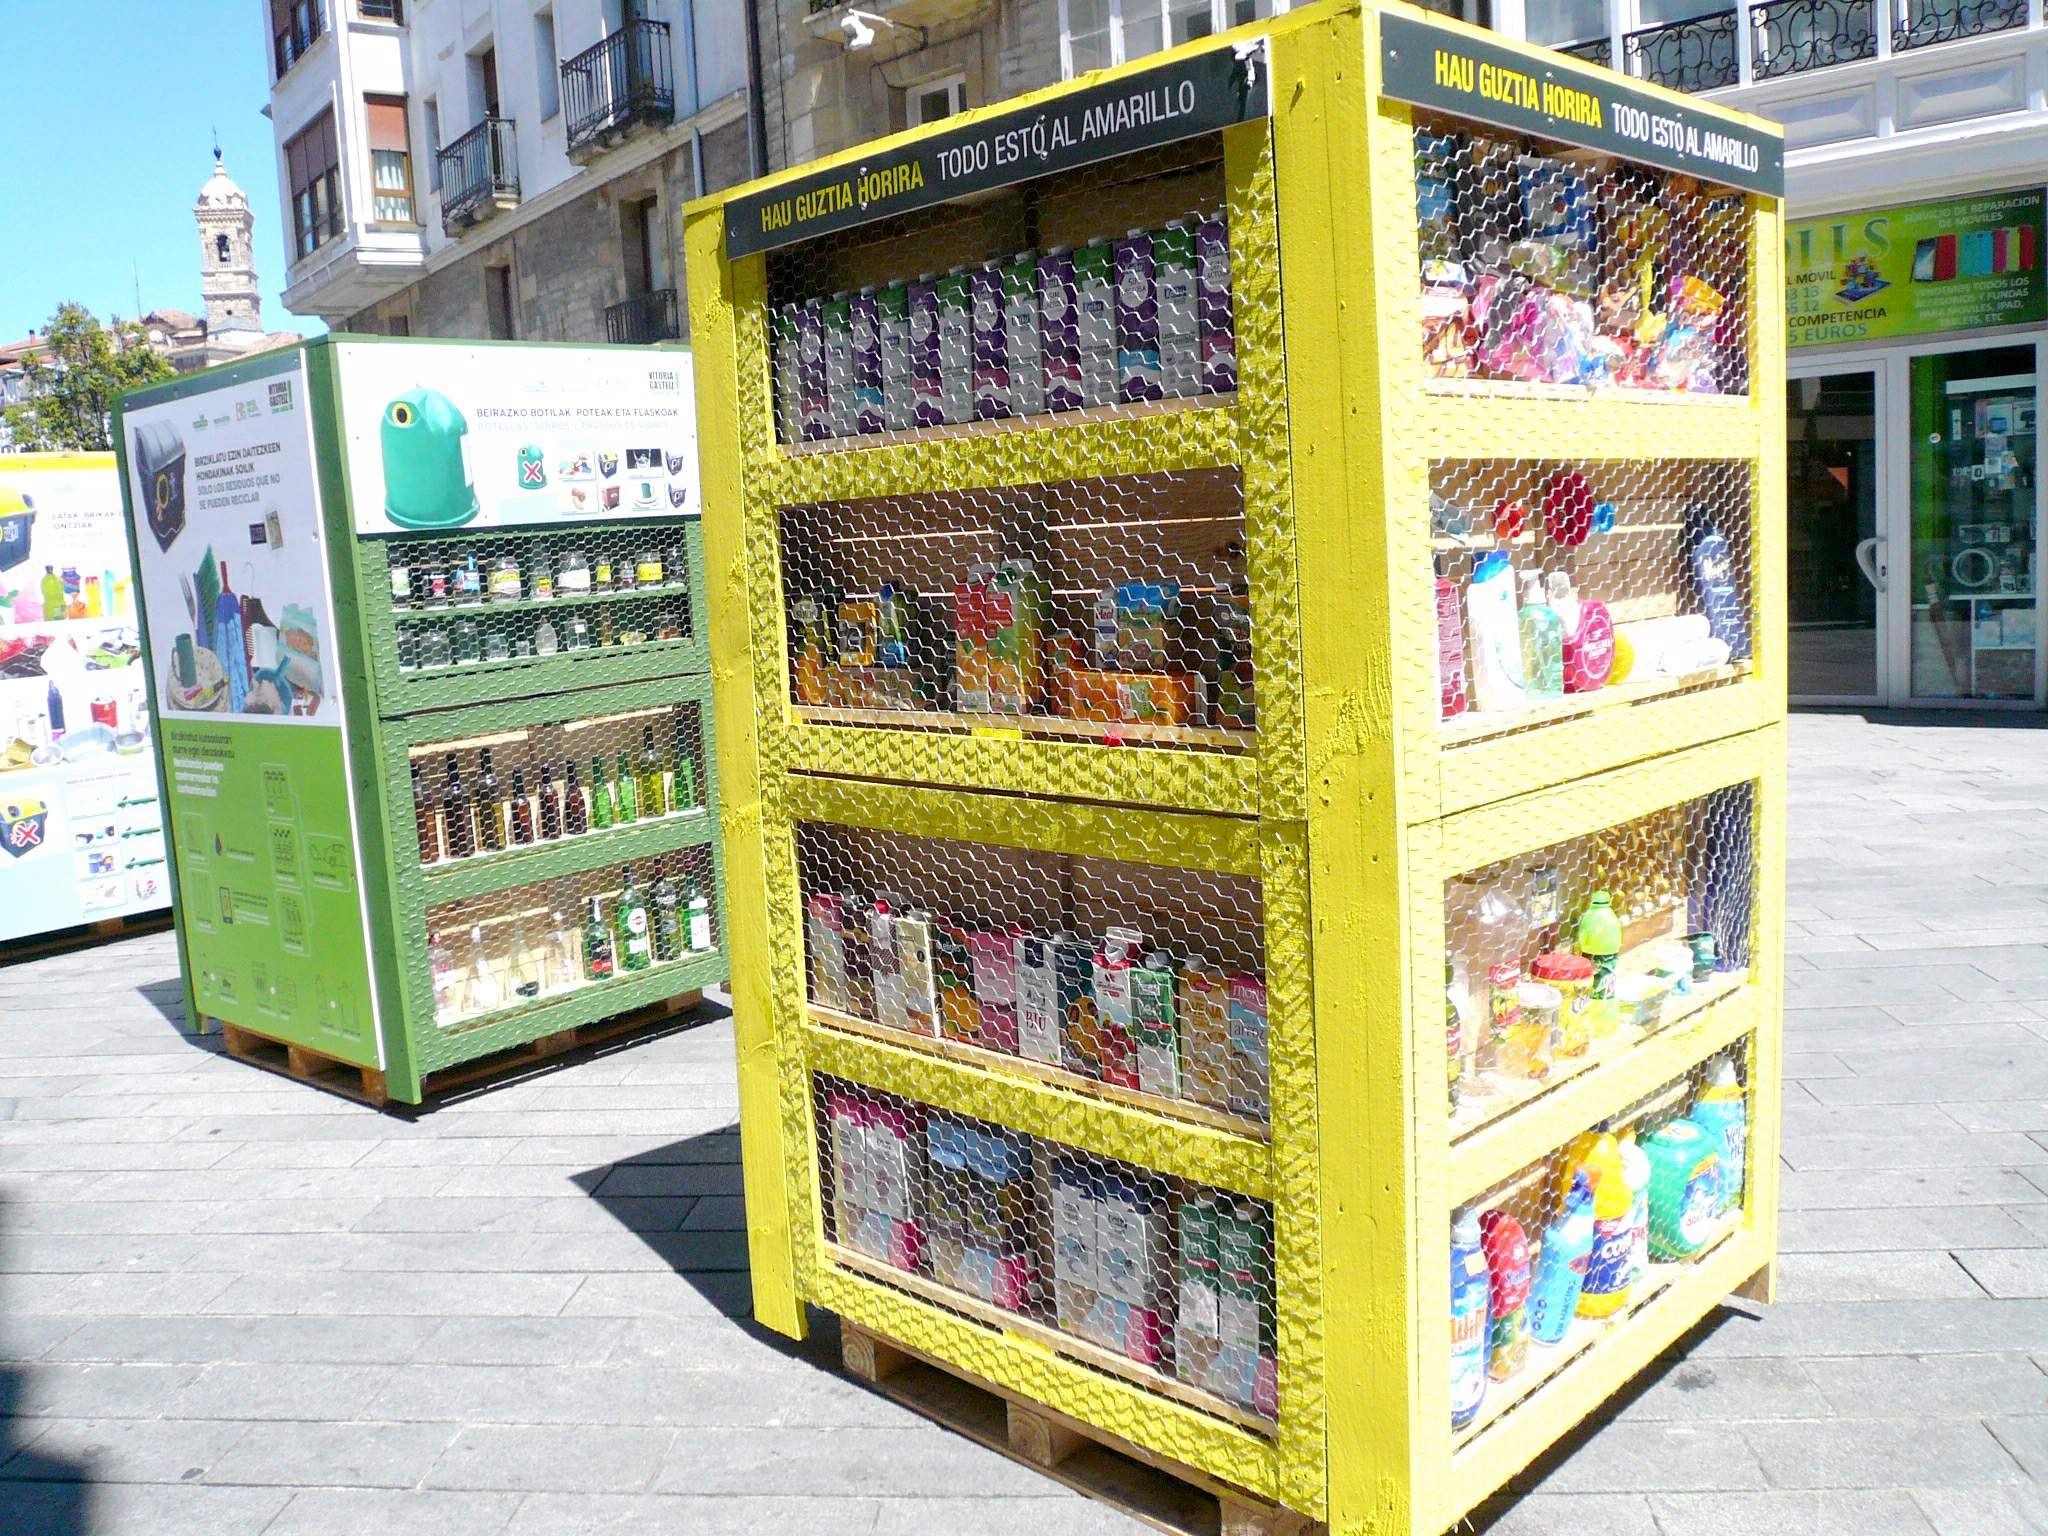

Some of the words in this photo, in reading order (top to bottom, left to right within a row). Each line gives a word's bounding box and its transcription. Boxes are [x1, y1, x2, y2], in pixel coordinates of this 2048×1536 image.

[1435, 50, 1474, 93] HAU
[1479, 63, 1540, 111] GUZTIA
[1543, 83, 1602, 128] HORIRA
[1612, 102, 1650, 144] TODO
[1686, 127, 1702, 157] AL
[1703, 131, 1759, 173] AMARILLO
[760, 202, 792, 232] HAU
[796, 184, 853, 223] GUZTIA
[857, 160, 924, 204] HORIRA
[937, 140, 989, 181] TODO
[1051, 119, 1078, 151] AL
[1082, 80, 1196, 142] AMARILLO
[1796, 271, 1837, 285] MOVIL
[1788, 307, 1888, 329] COMPETENCIA
[1804, 322, 1868, 341] EUROS
[476, 408, 528, 418] BEIRAZKO
[615, 408, 632, 417] ETA
